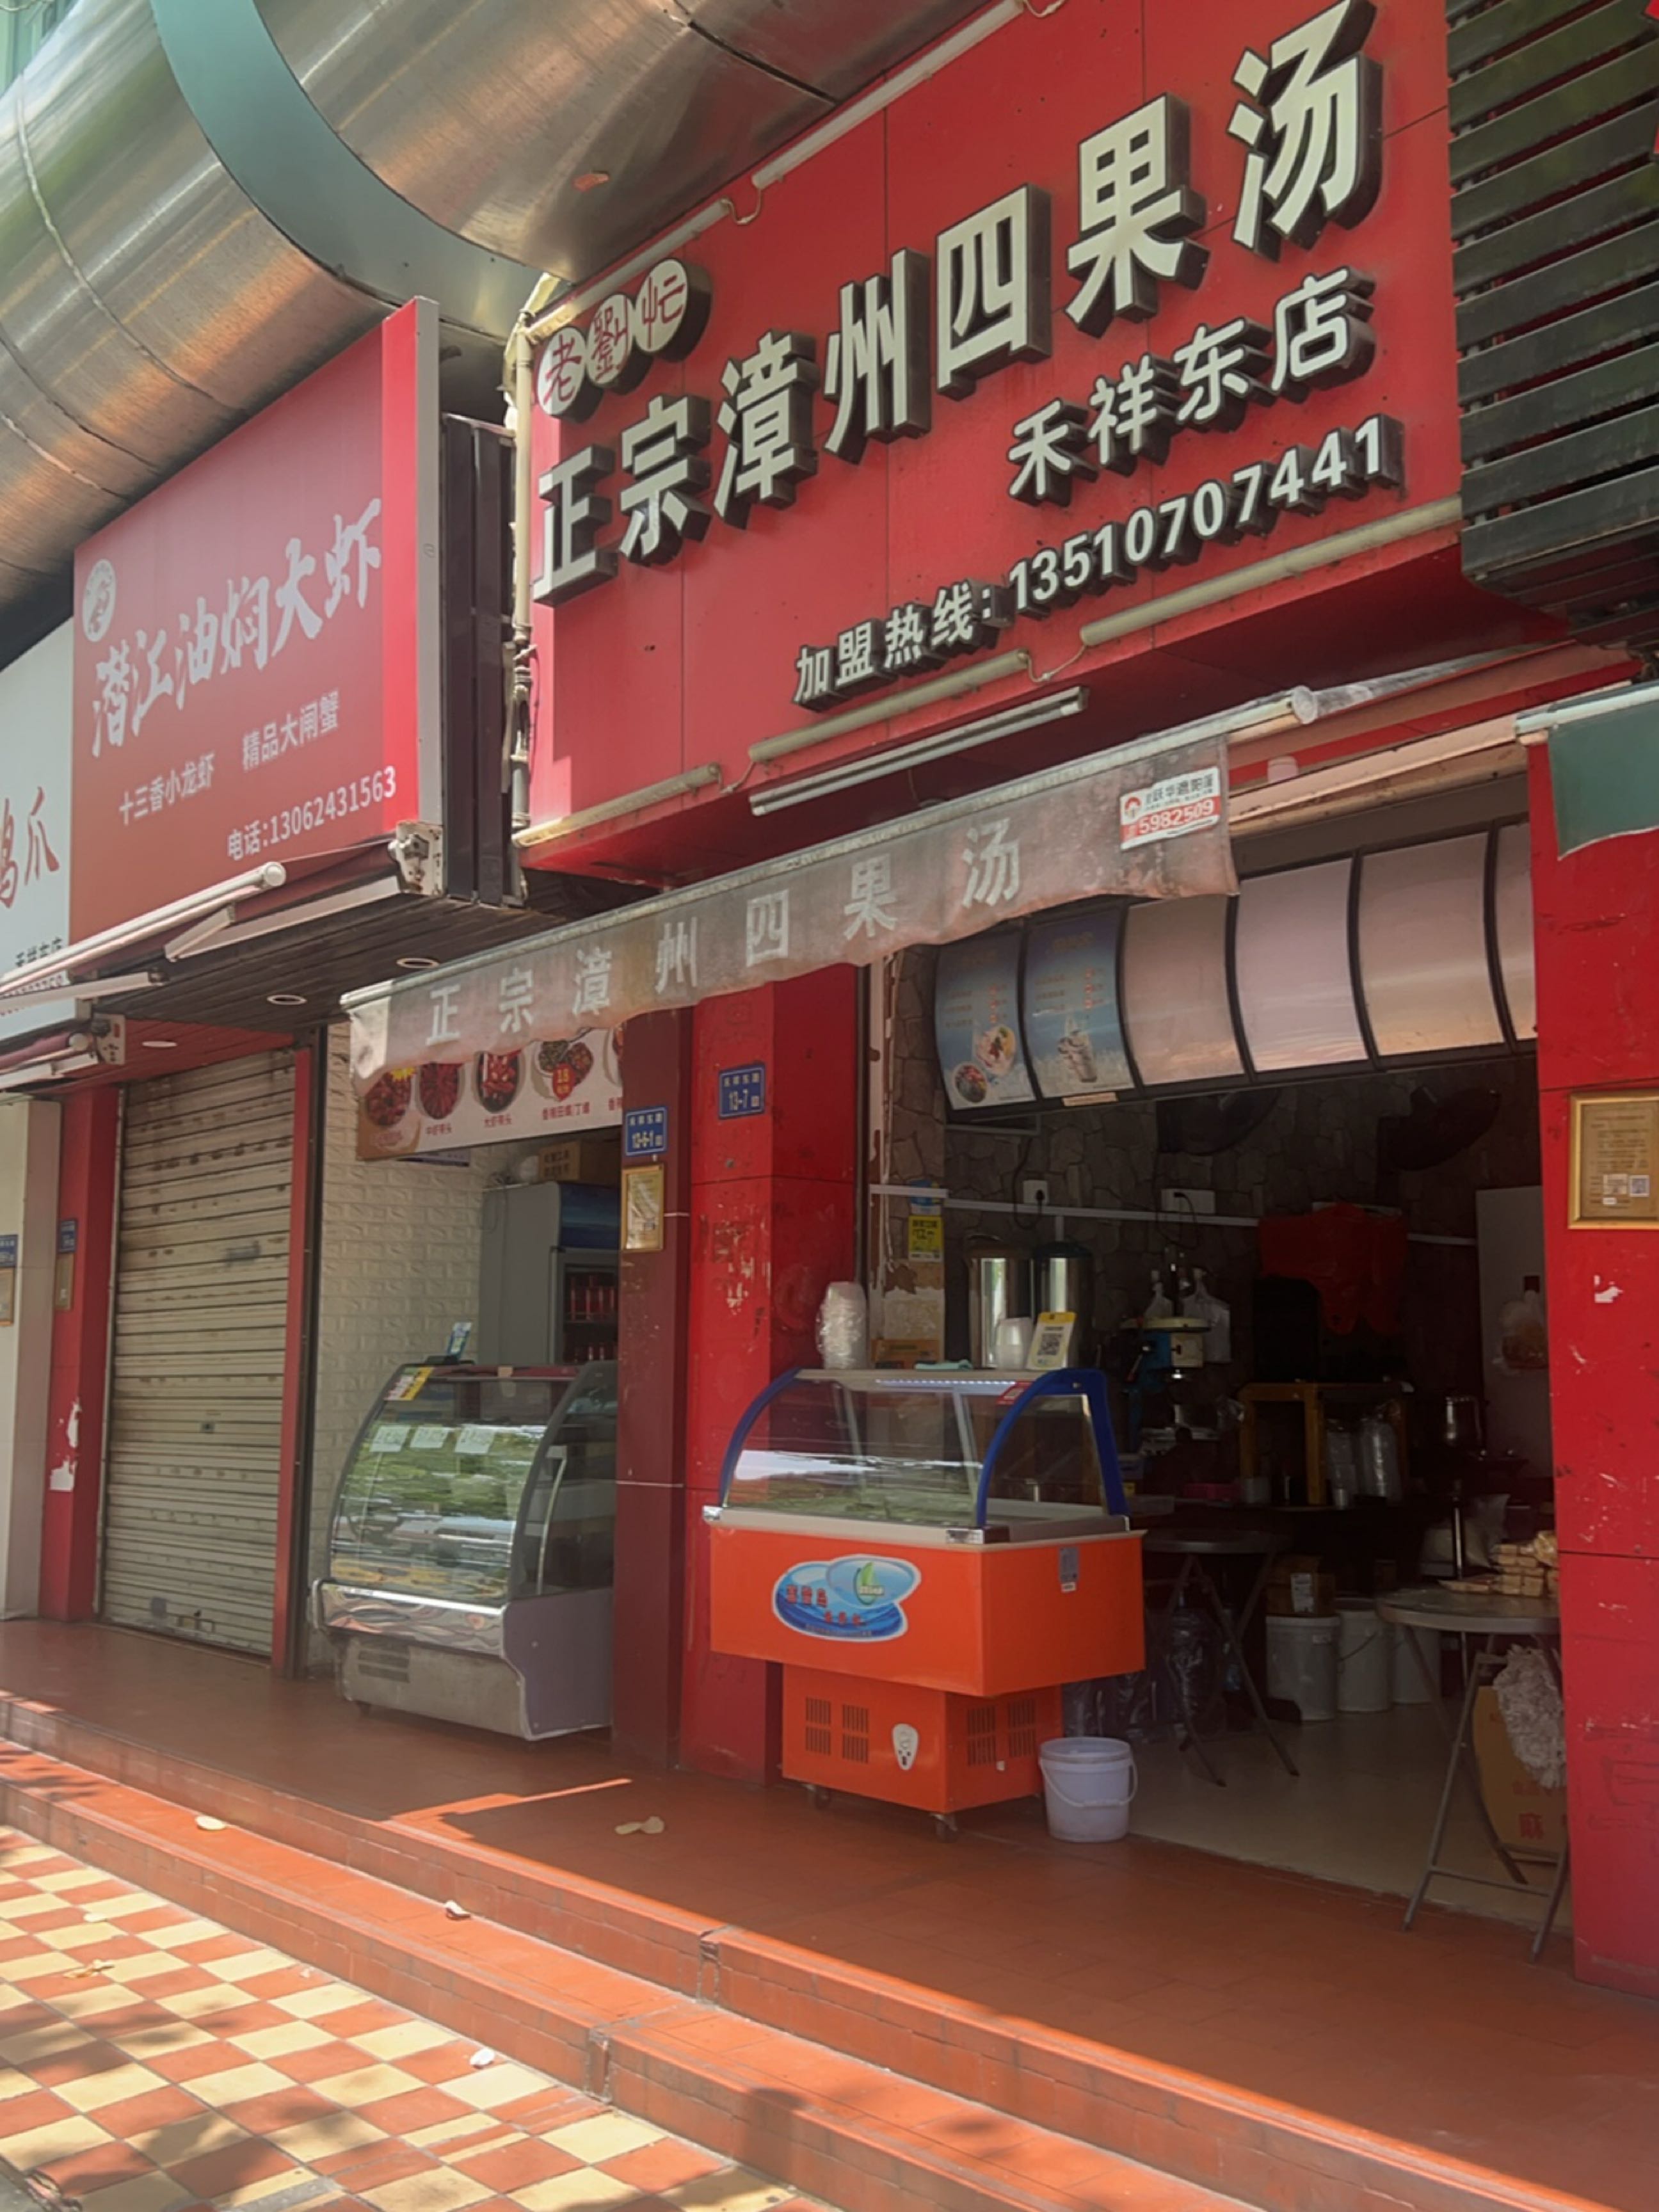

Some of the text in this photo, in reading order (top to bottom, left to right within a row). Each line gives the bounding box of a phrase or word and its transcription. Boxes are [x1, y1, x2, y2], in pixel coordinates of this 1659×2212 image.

[533, 0, 1361, 605] 正宗漳州四果汤
[1008, 268, 1349, 499] 禾祥东店
[91, 497, 382, 758] 潜江油焖大虾
[425, 817, 1020, 1046] 正宗漳州四果汤
[1139, 798, 1214, 835] 5982509
